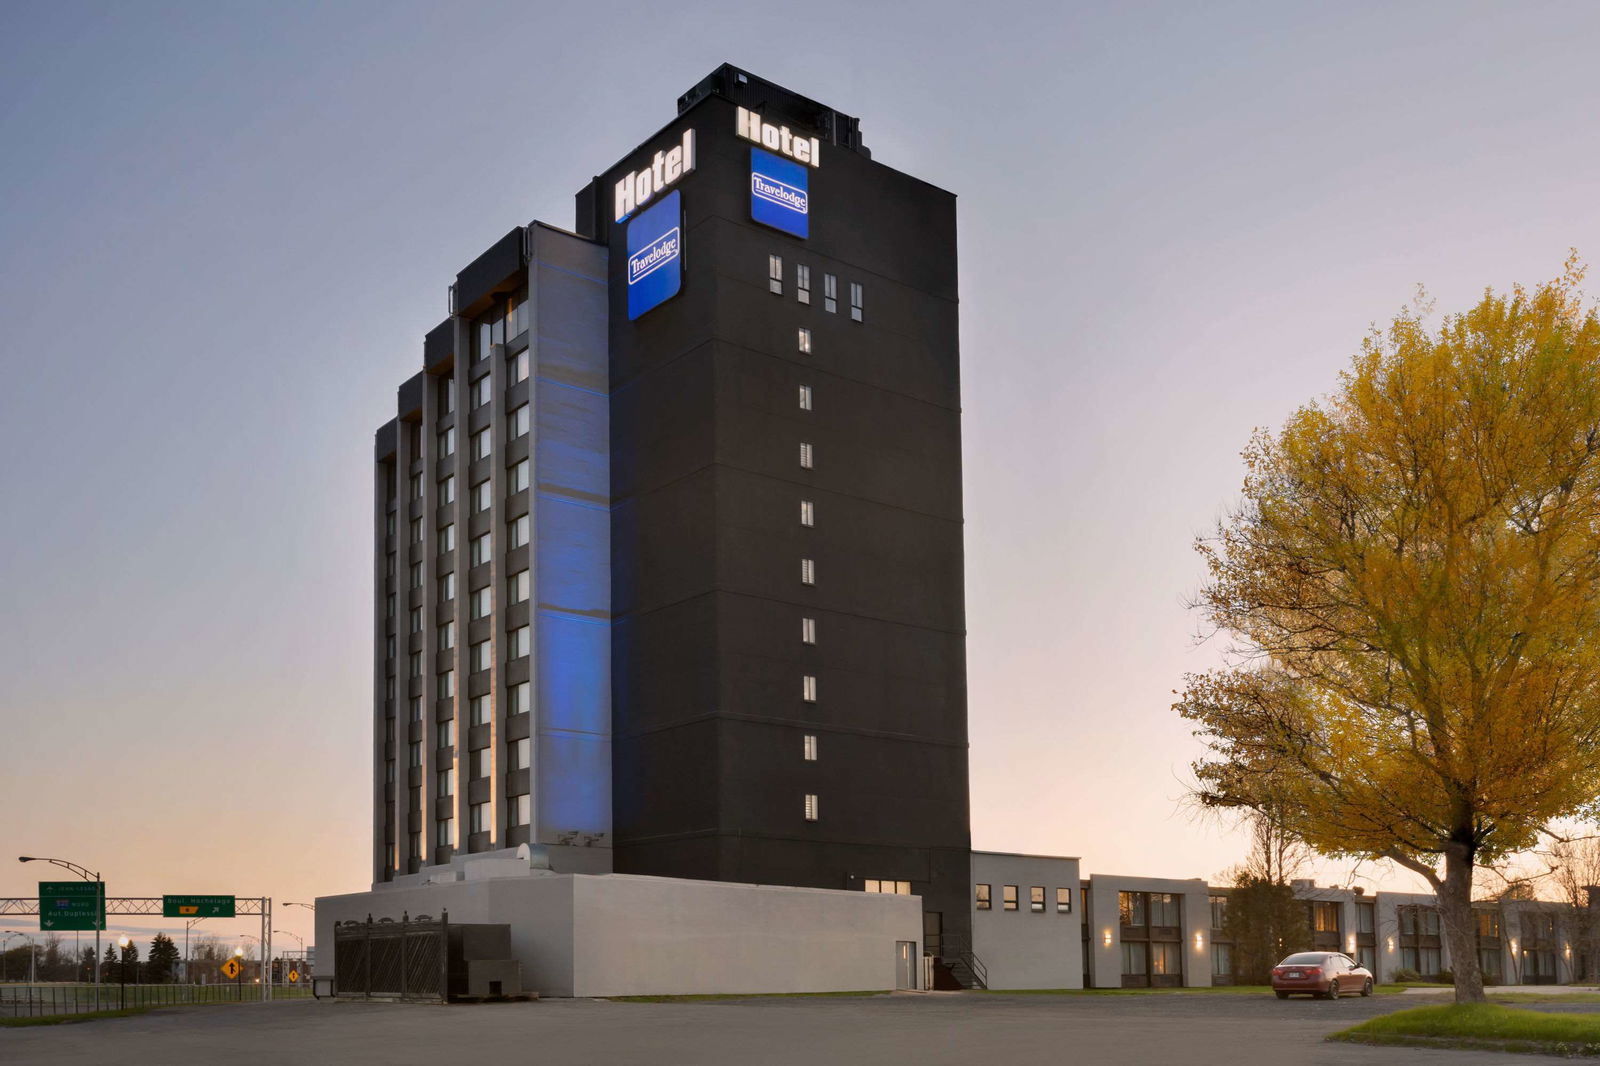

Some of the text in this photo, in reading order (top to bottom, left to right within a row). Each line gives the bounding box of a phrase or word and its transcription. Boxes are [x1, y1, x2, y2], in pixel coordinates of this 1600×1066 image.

[735, 105, 820, 168] Hotel
[615, 128, 696, 222] Hotel
[754, 177, 806, 208] Travelodge
[631, 237, 676, 273] Travelodge
